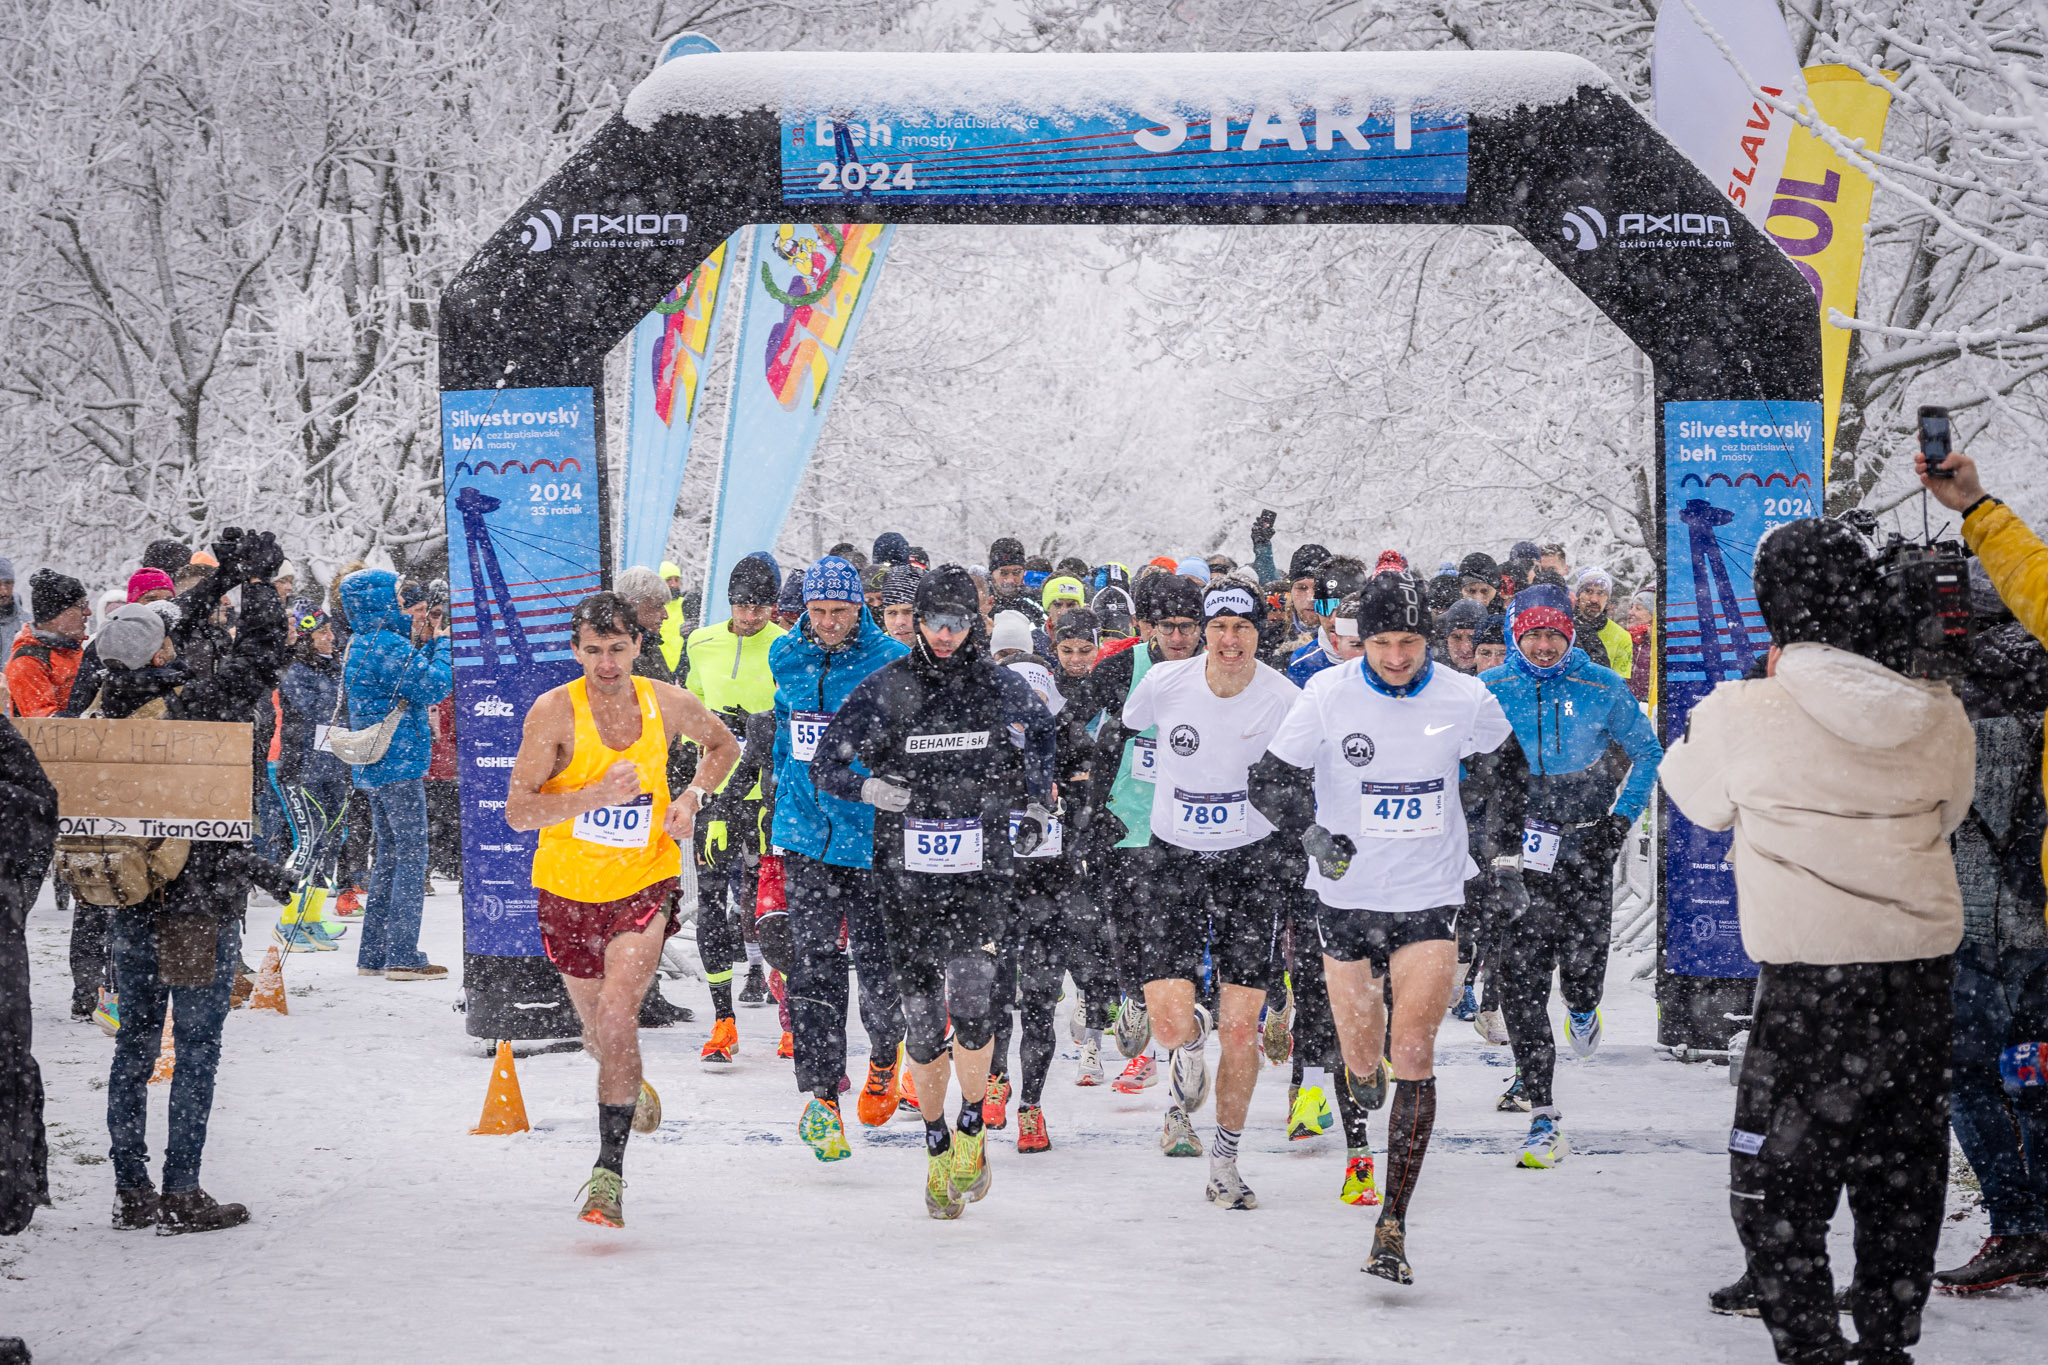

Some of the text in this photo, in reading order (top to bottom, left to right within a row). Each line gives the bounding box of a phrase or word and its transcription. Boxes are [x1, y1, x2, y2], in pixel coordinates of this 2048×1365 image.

[815, 115, 892, 147] beh
[816, 161, 916, 191] 2024
[573, 214, 688, 234] AXION
[1619, 213, 1731, 235] AXION
[572, 238, 685, 248] axion4event.com
[1619, 239, 1732, 248] axion4event.com
[451, 405, 580, 428] Silvestrovský
[452, 433, 484, 450] beh
[504, 429, 560, 439] bratislavské
[1679, 420, 1812, 442] Silvestrovský
[487, 441, 517, 451] mosty
[1680, 442, 1795, 462] beh cez bratislavské
[1721, 454, 1754, 463] mosty
[529, 483, 582, 502] 2024
[530, 505, 549, 516] 33.
[1763, 498, 1812, 516] 2024
[583, 807, 639, 830] 1010
[1182, 804, 1228, 824] 780
[1374, 798, 1422, 820] 478
[139, 819, 252, 839] TitanGOAT
[917, 834, 962, 855] 587
